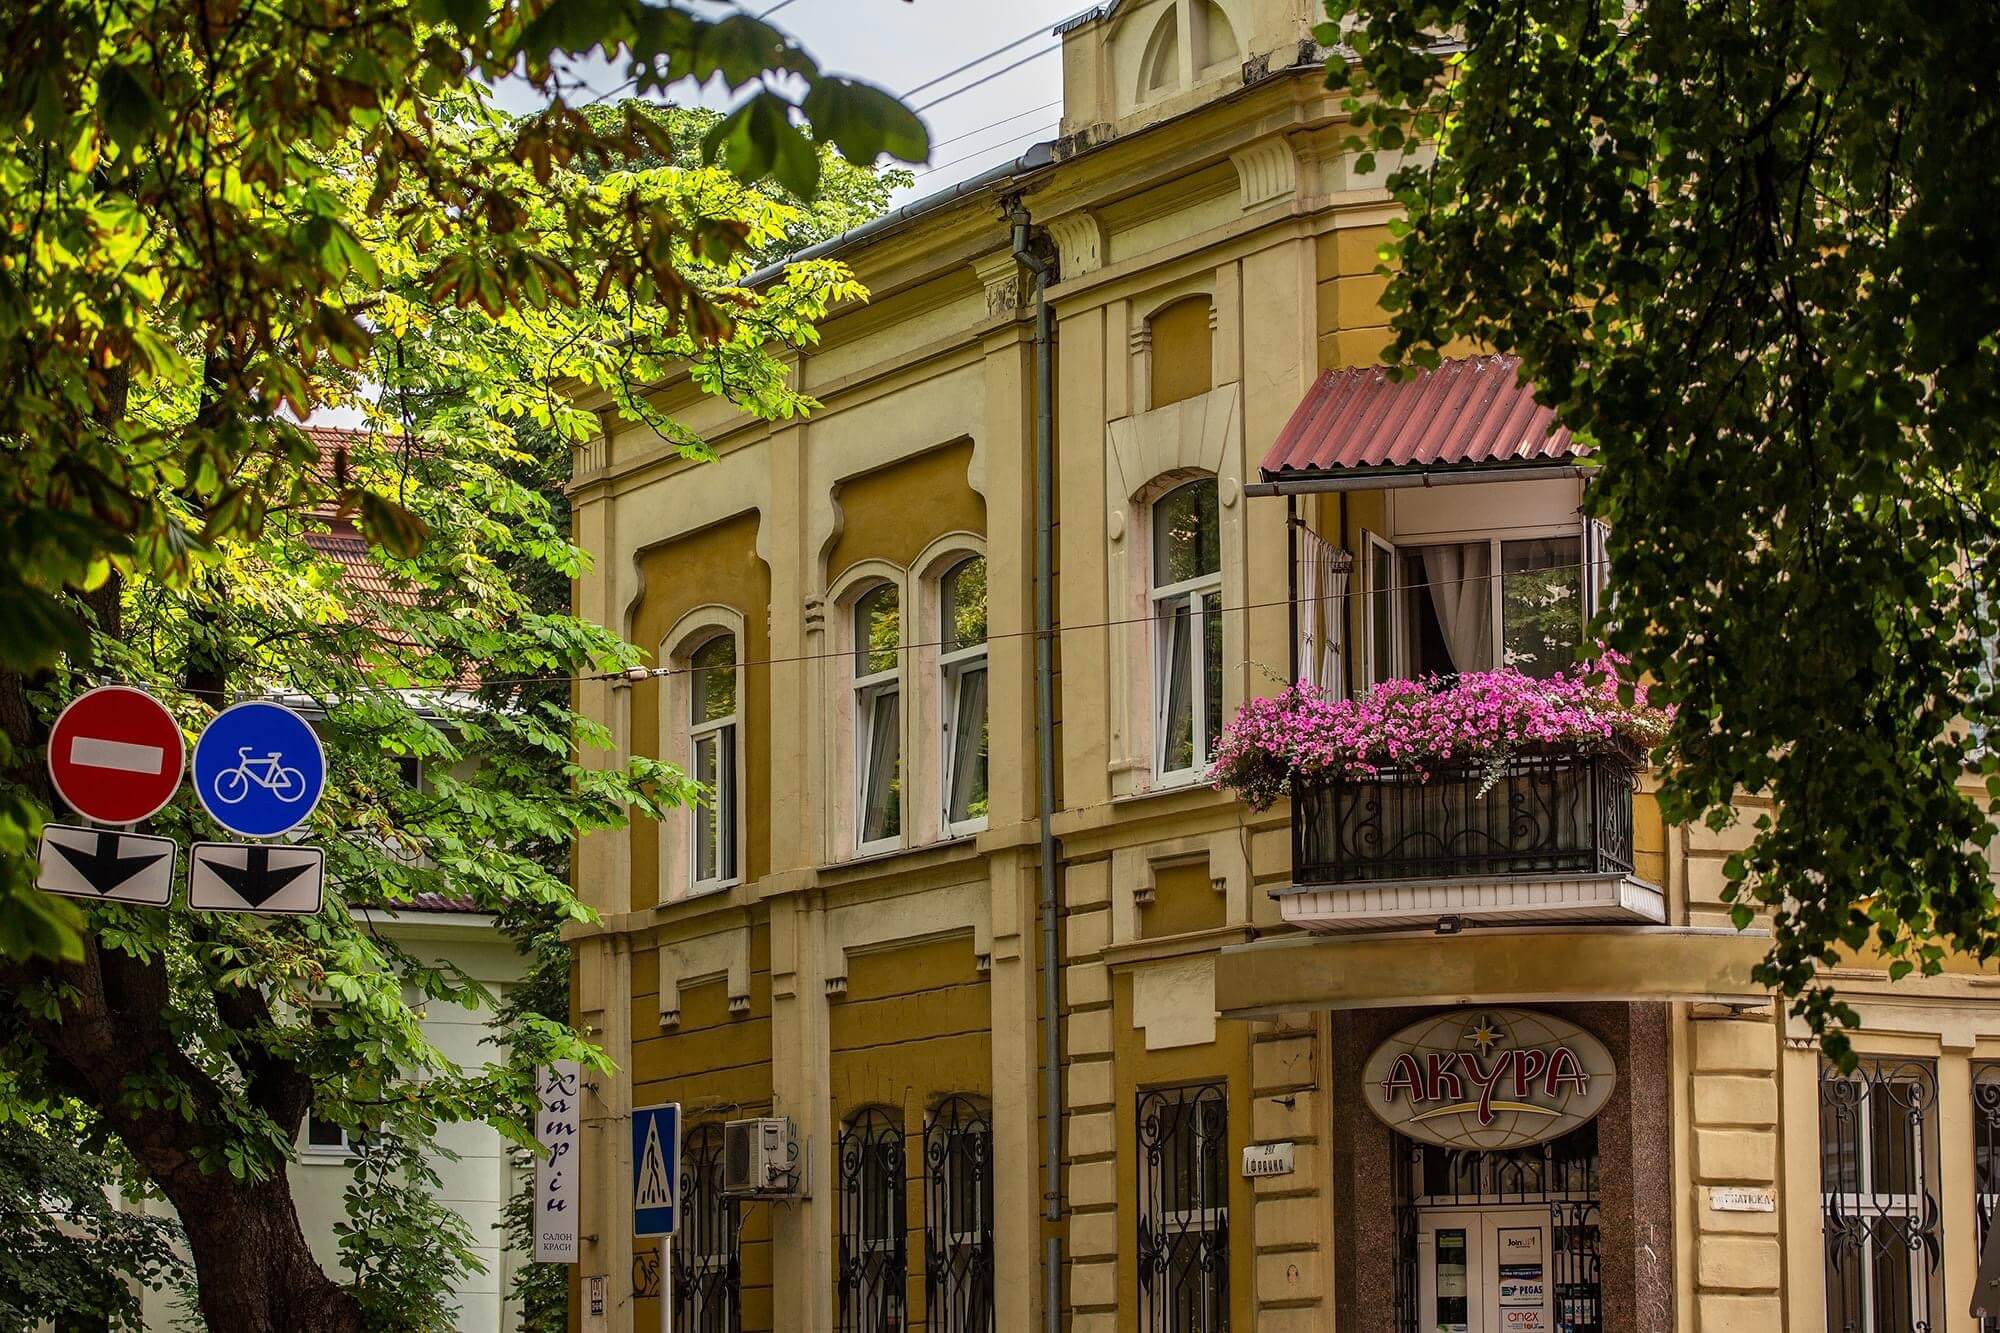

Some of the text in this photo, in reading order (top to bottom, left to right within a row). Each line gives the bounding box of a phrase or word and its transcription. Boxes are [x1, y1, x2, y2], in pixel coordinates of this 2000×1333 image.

[1381, 1047, 1591, 1127] АКУРА
[543, 1232, 572, 1241] САЛОН
[1507, 1238, 1522, 1246] Join
[543, 1243, 572, 1252] КРАСИ
[1519, 1285, 1543, 1295] PEGAS
[1507, 1312, 1539, 1322] anex
